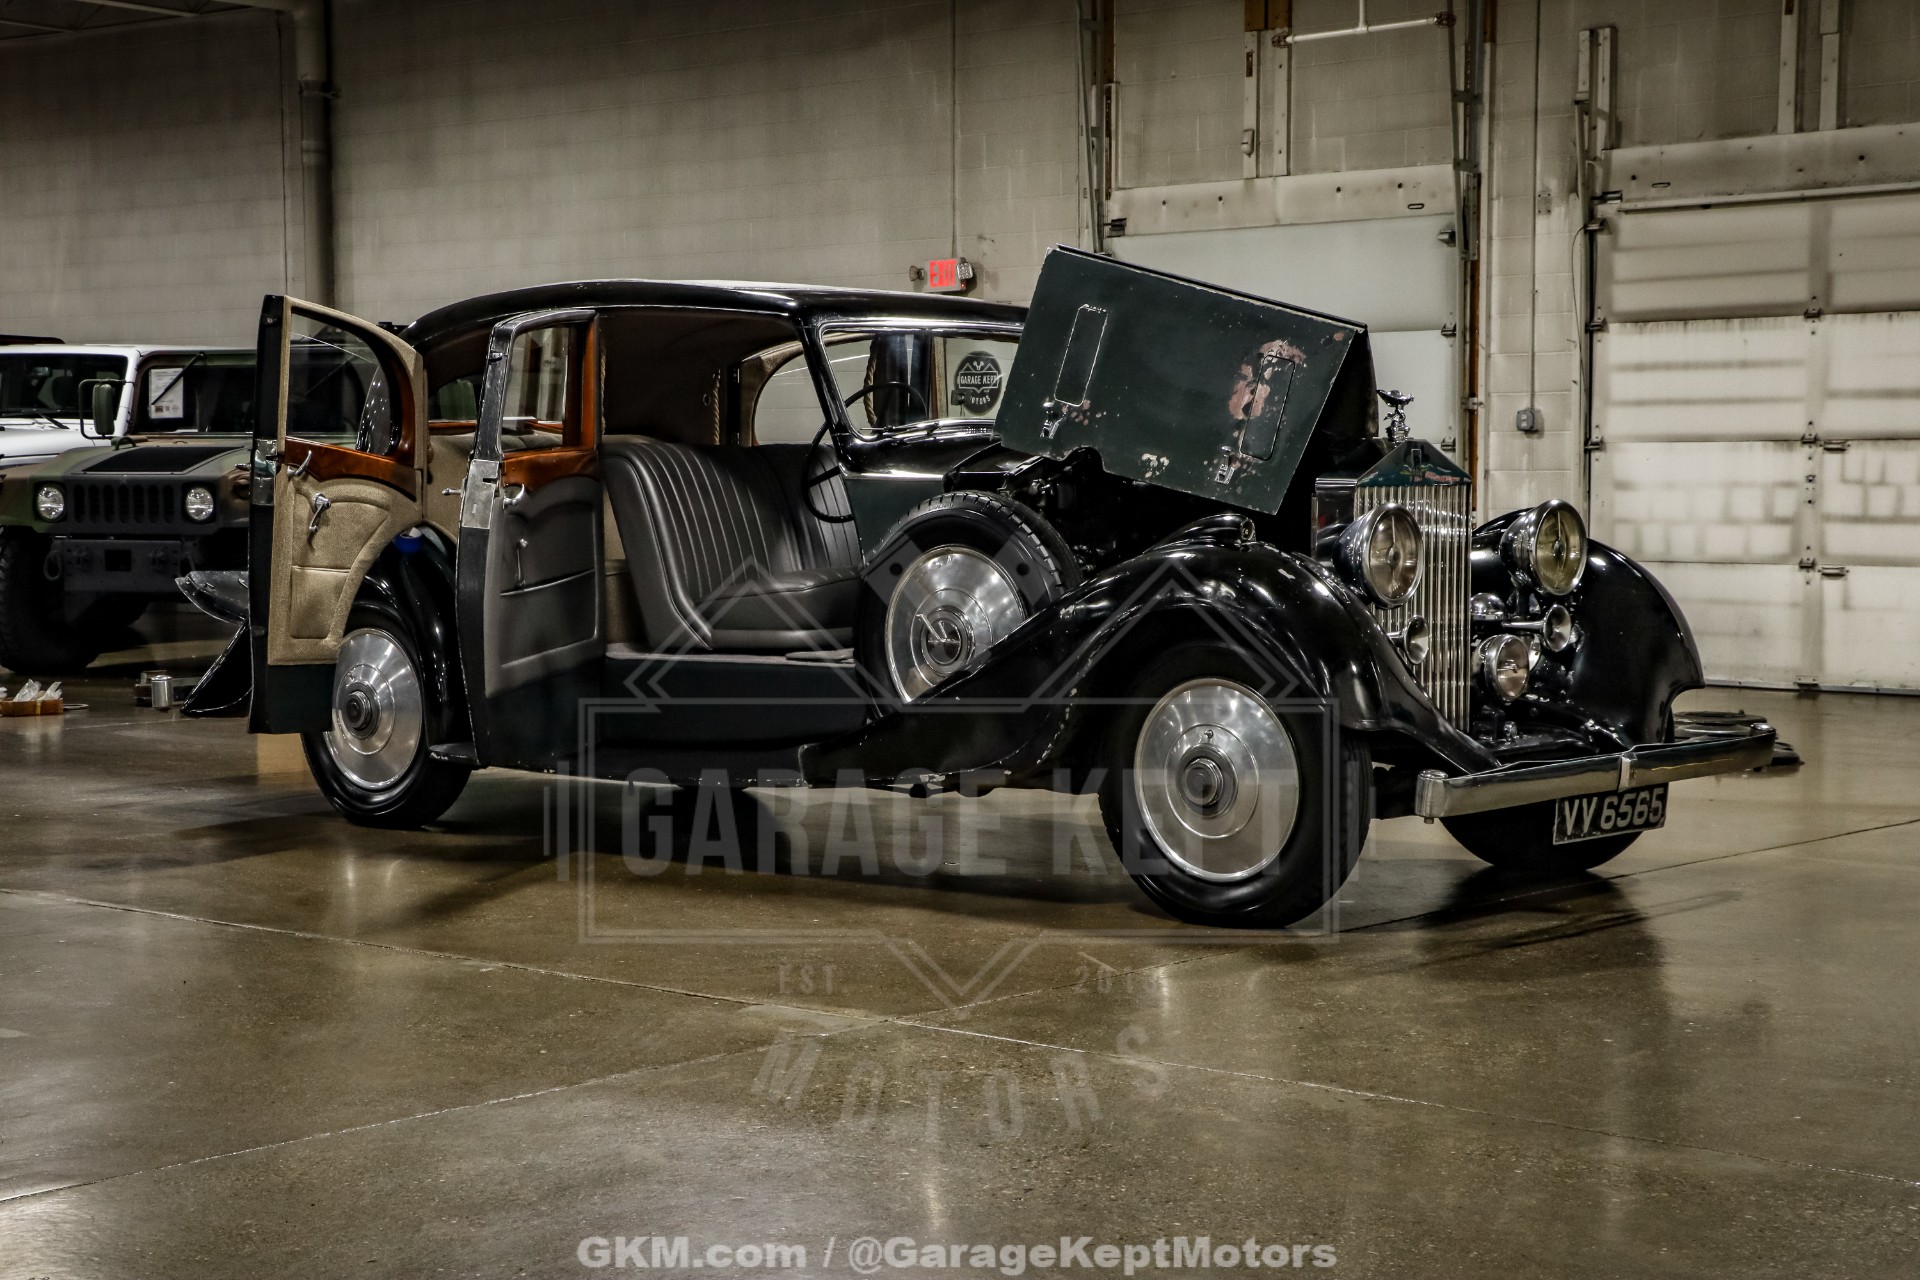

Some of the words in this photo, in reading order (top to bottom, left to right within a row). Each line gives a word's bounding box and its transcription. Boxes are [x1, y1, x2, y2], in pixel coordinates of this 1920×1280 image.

[929, 259, 957, 288] EXIT
[960, 375, 981, 385] GARAGE
[1601, 787, 1665, 830] 6565
